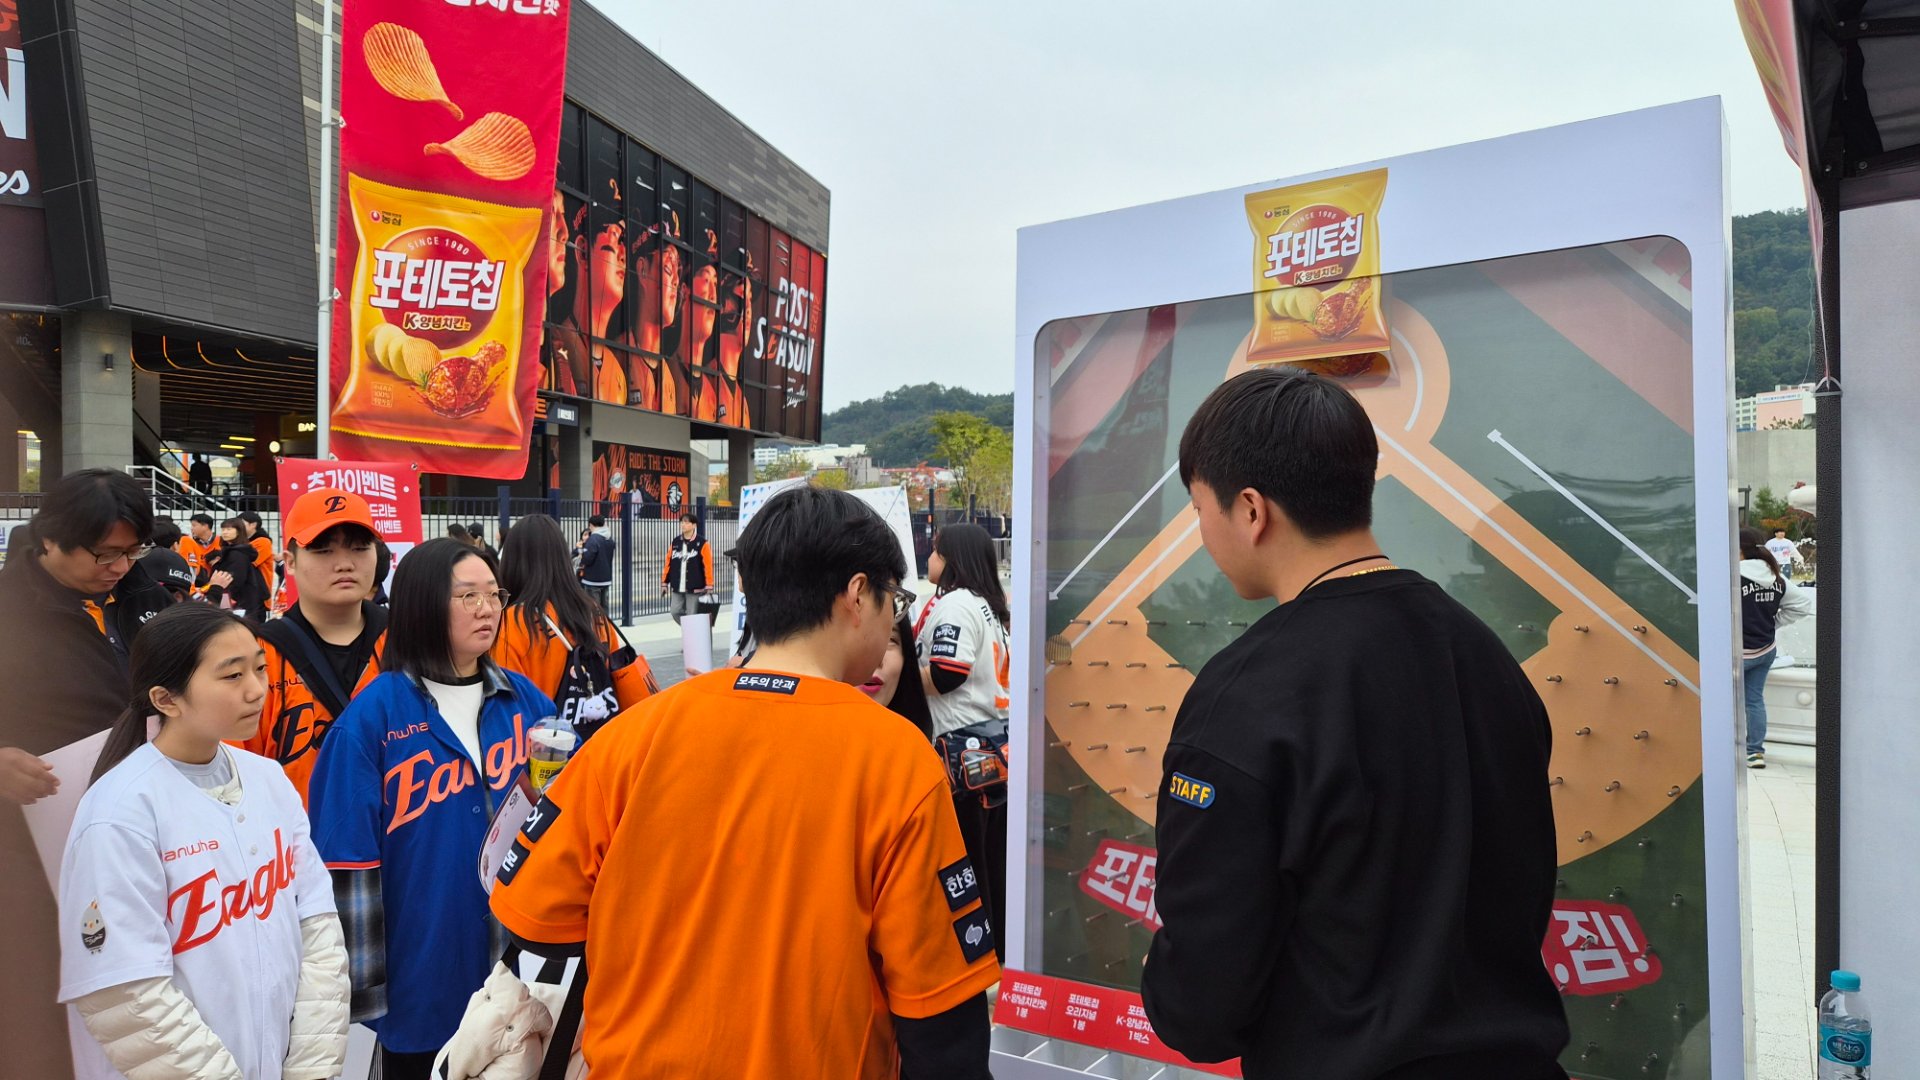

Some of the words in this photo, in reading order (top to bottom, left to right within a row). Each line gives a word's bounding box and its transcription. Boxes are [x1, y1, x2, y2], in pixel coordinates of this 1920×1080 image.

[407, 236, 441, 251] SINCE
[444, 238, 470, 255] 1980
[1264, 213, 1364, 278] 포테토칩
[369, 249, 506, 312] 포테토칩
[774, 276, 814, 330] POST
[753, 316, 815, 376] SEASON
[629, 452, 646, 469] RIDE
[648, 454, 661, 471] THE
[663, 456, 687, 474] STORM
[1755, 591, 1775, 602] CLUB
[736, 676, 770, 688] 모두의
[771, 678, 796, 690] 안과
[1170, 775, 1212, 804] STAFF
[160, 839, 220, 862] anwha
[1012, 981, 1042, 998] 포테토칩
[1002, 991, 1048, 1011] K-양념치킨맛
[1068, 993, 1100, 1009] 포테토칩
[1015, 1007, 1029, 1019] 1봉
[1065, 1005, 1098, 1021] 오리지널
[1072, 1019, 1086, 1031] 1봉
[1128, 1031, 1150, 1045] 1박스
